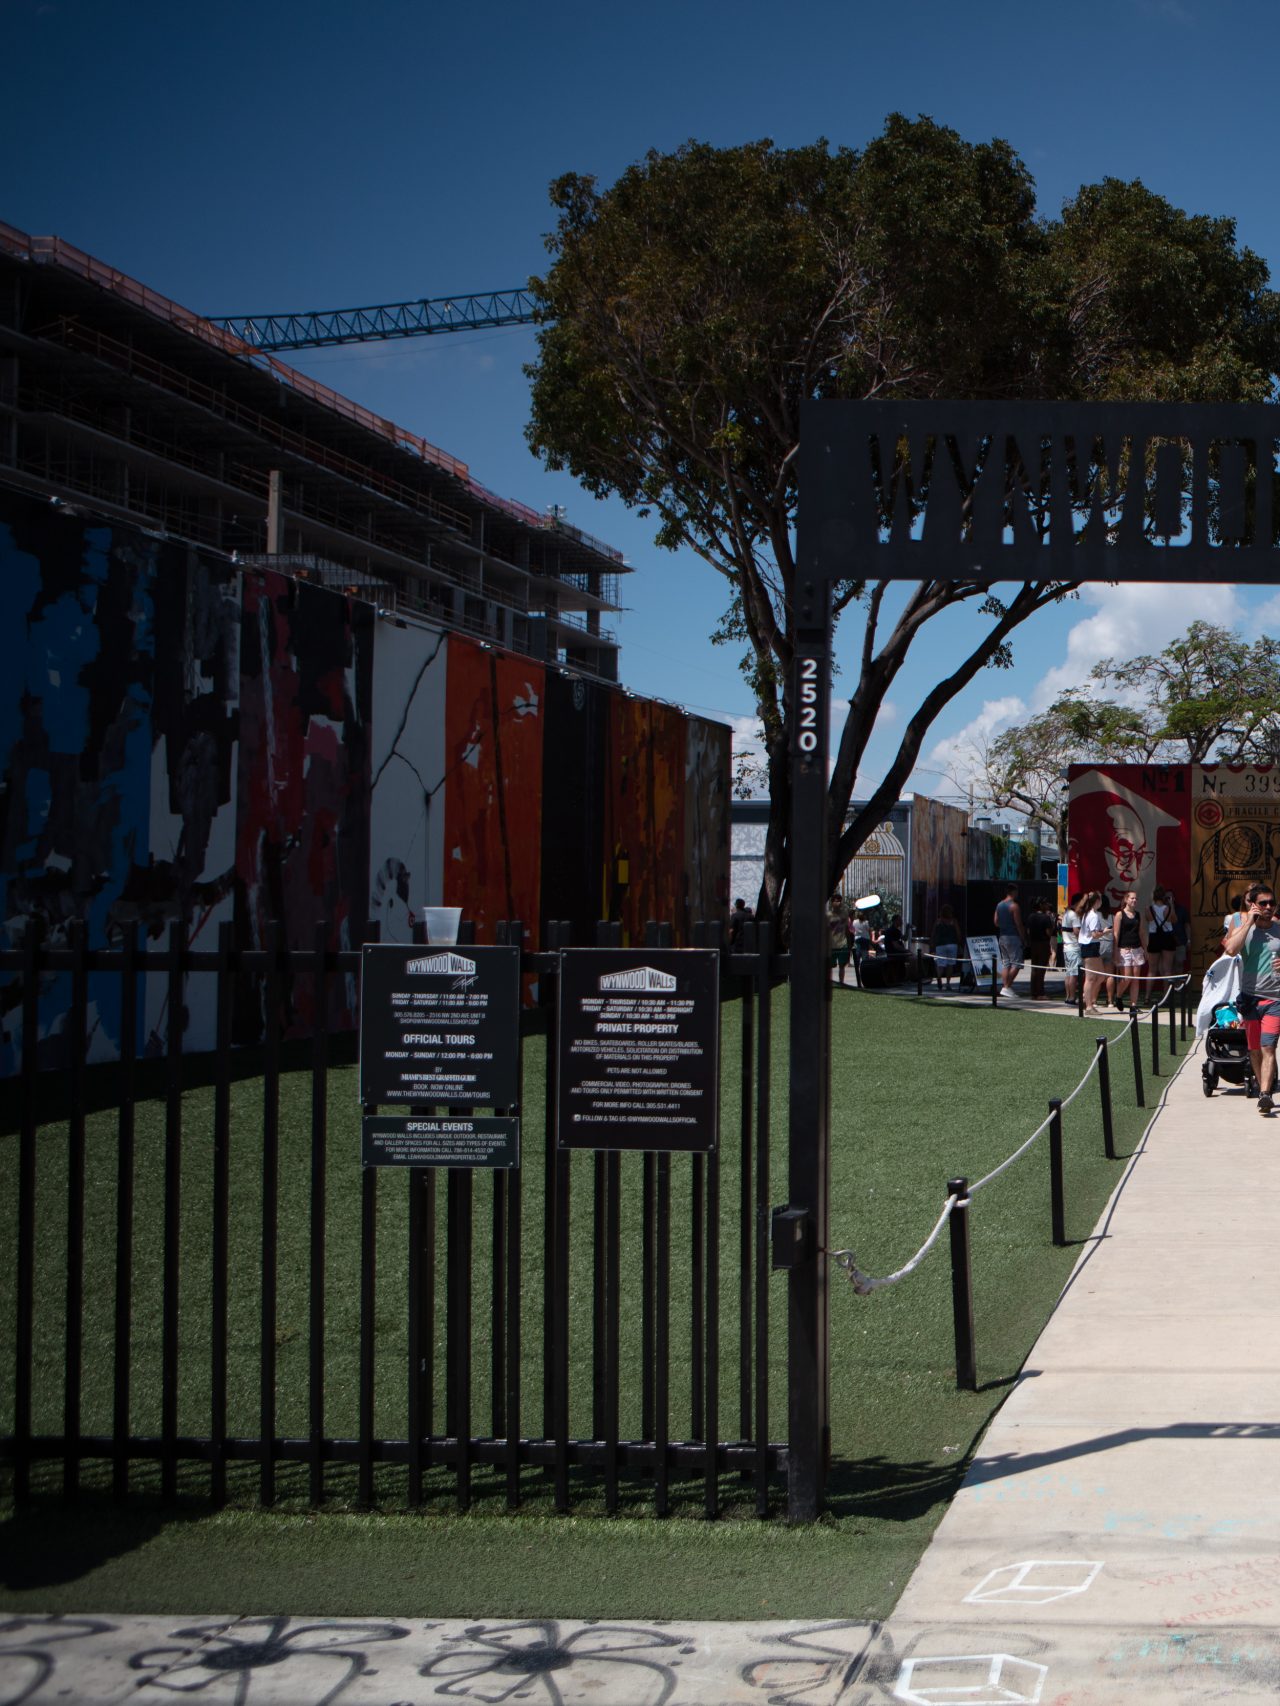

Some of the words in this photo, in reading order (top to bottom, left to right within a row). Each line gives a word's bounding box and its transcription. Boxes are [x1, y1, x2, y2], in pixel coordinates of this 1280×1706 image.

[799, 659, 818, 751] 2520
[1202, 775, 1225, 795] Nr
[1229, 807, 1269, 817] FRAGILE
[408, 955, 448, 973] WYNWOOD
[450, 954, 475, 972] WALLS
[603, 970, 646, 989] WYNWOOD
[648, 971, 674, 988] WALLS
[597, 1023, 631, 1033] PRIVATE
[634, 1024, 679, 1033] PROPERTY
[403, 1034, 443, 1044] OFFICIAL
[446, 1035, 475, 1045] TOURS
[407, 1123, 440, 1131] SPECIAL
[443, 1123, 474, 1131] EVENTS
